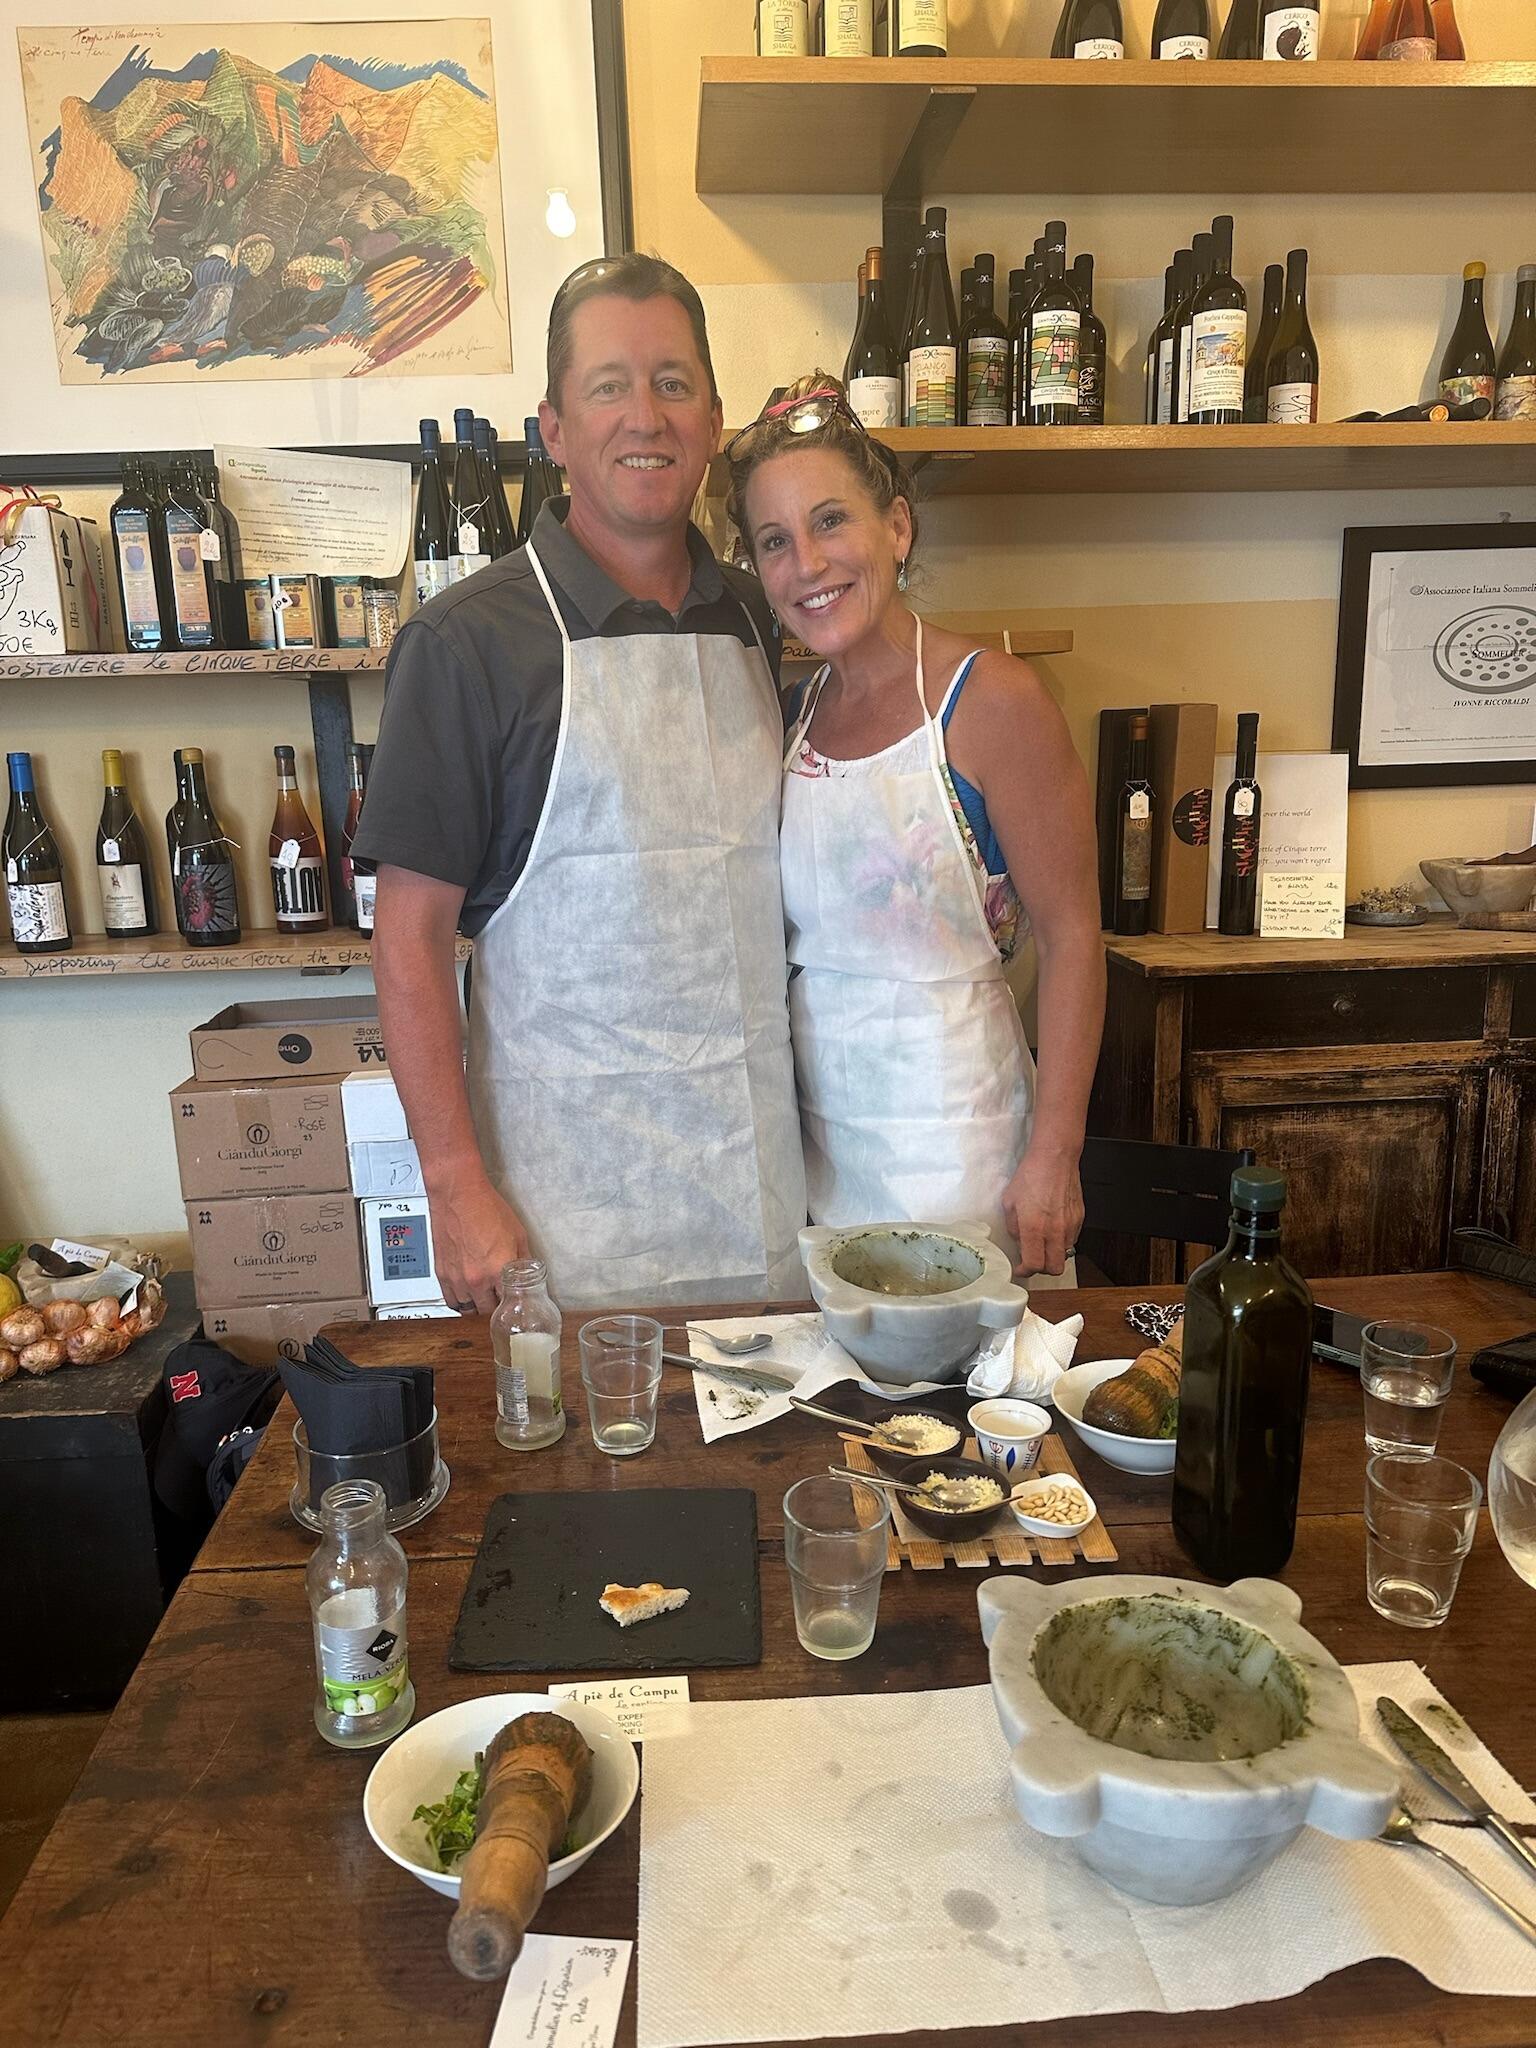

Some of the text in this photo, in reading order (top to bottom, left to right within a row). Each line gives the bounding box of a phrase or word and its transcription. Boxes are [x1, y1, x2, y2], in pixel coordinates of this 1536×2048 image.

[1424, 586, 1471, 595] Associazione
[1473, 585, 1501, 594] Italiana
[1280, 809, 1290, 817] the
[1291, 808, 1312, 816] world
[1275, 845, 1282, 855] of
[1283, 845, 1308, 855] Cinque
[1310, 858, 1331, 866] regret
[170, 1370, 201, 1403] N
[352, 1670, 382, 1681] MELA
[563, 1690, 578, 1701] A
[609, 1687, 623, 1699] de
[629, 1685, 679, 1699] Campu
